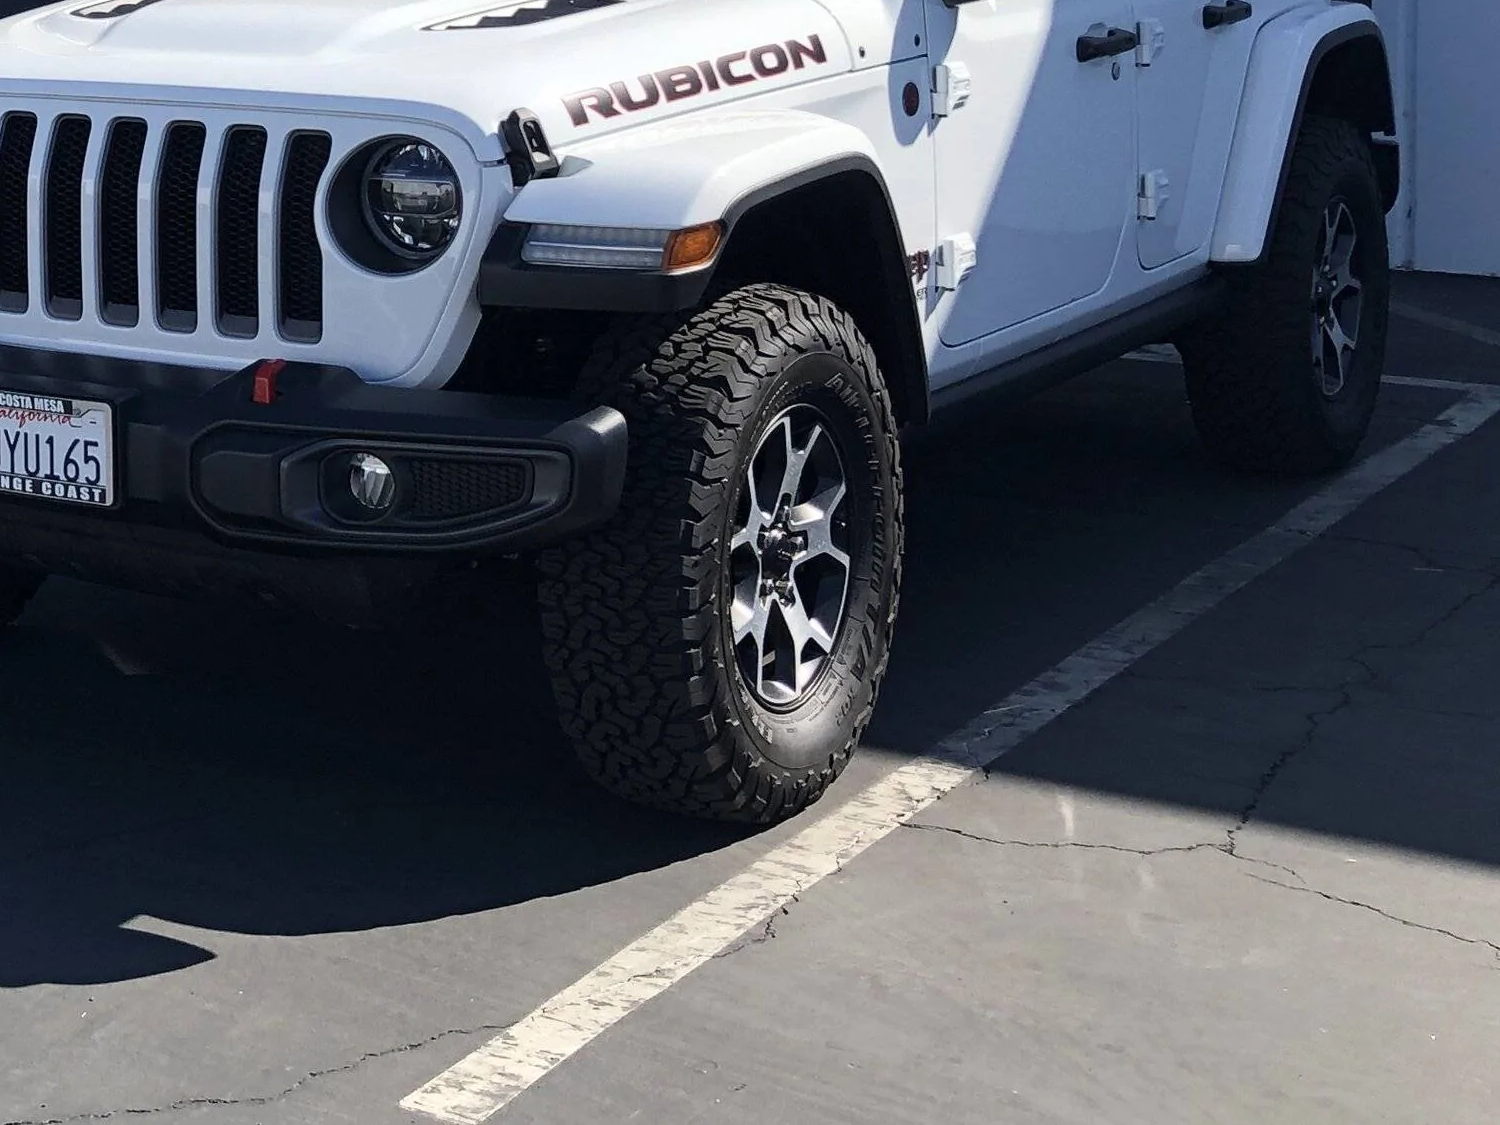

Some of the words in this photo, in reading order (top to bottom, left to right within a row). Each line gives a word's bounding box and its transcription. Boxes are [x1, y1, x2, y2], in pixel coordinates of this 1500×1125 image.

[560, 34, 827, 128] RUBICON
[34, 397, 65, 413] MESA
[41, 481, 102, 503] COAST
